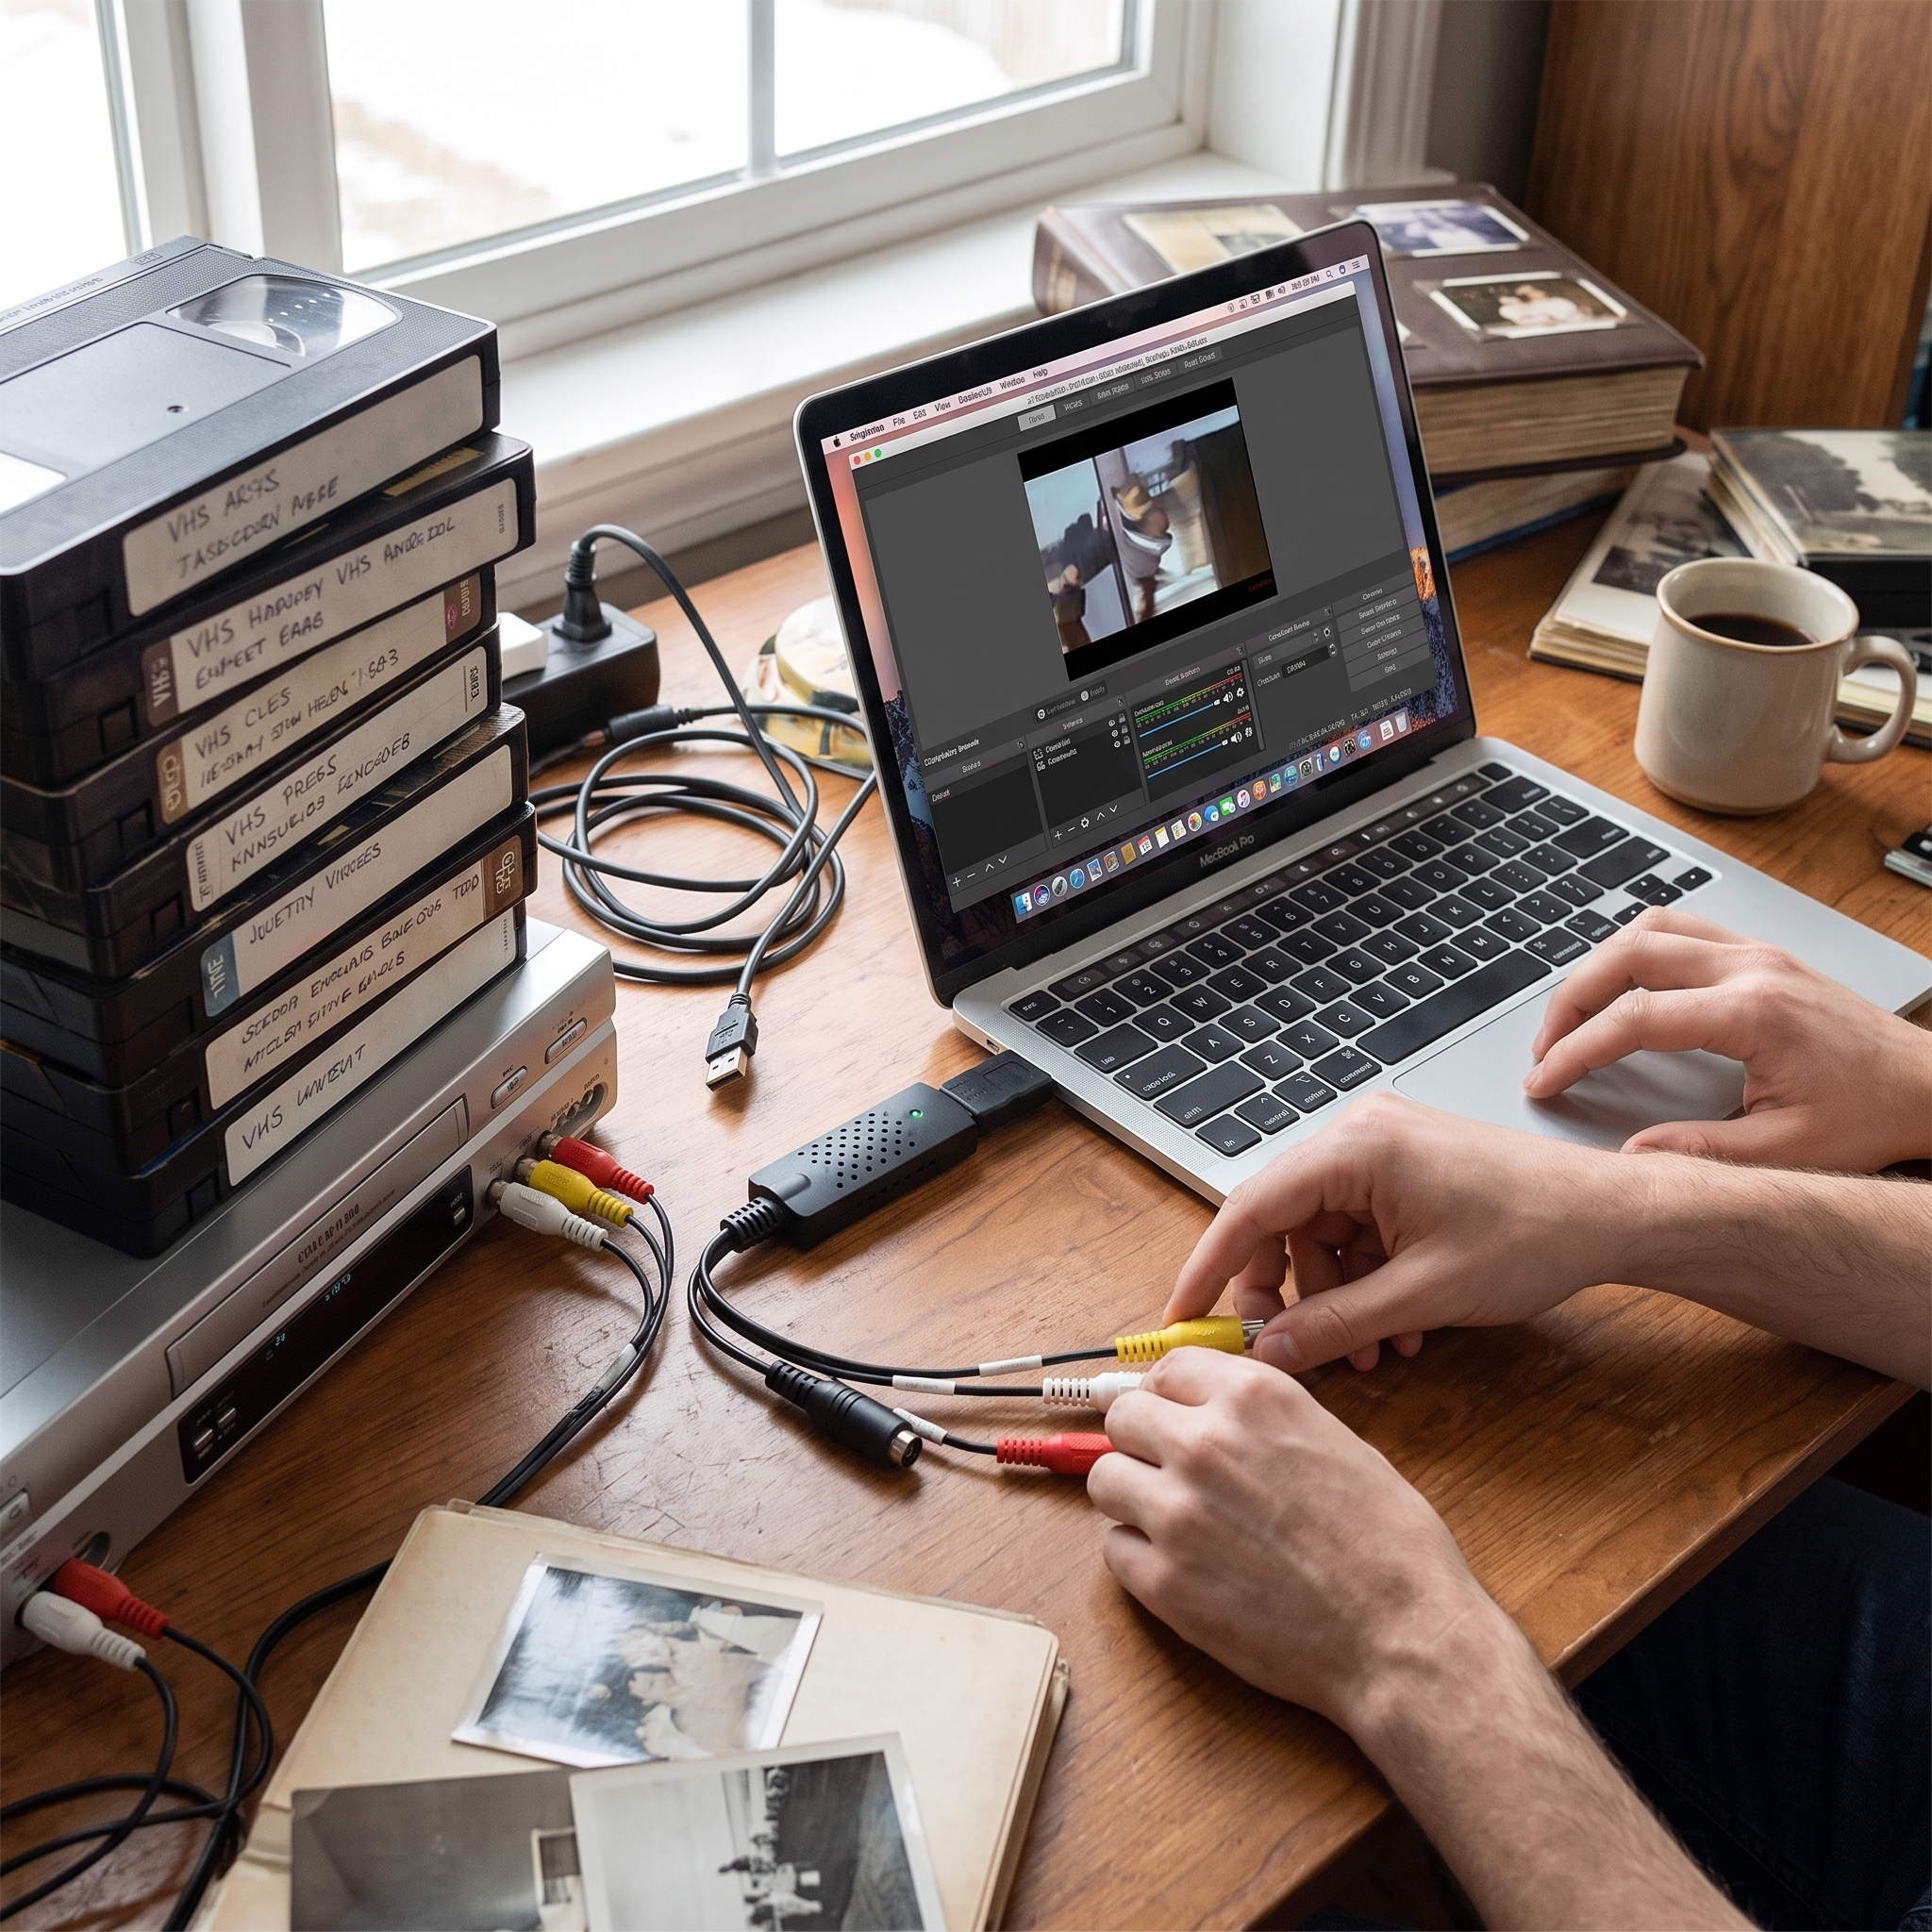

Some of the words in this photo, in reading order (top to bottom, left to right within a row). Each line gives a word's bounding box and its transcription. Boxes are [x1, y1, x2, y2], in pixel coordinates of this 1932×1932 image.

[167, 505, 209, 543] VHS
[187, 619, 235, 658] VHS
[336, 555, 373, 586] VHS
[195, 724, 232, 759] VHS
[225, 806, 266, 846] VHS
[1464, 854, 1474, 863] P
[1433, 871, 1445, 879] O
[1319, 894, 1329, 904] 7
[1368, 905, 1382, 914] U
[1449, 907, 1462, 915] K
[1285, 912, 1297, 921] 6
[1334, 923, 1346, 931] Y
[1419, 924, 1429, 933] J
[1250, 930, 1263, 939] 5
[1300, 941, 1312, 949] T
[1383, 941, 1397, 951] H
[1473, 937, 1489, 947] M
[1265, 959, 1279, 969] R
[1349, 960, 1362, 969] G
[1441, 956, 1456, 965] N
[1180, 967, 1192, 975] 3
[1230, 978, 1243, 988] E
[1407, 974, 1421, 984] B
[1314, 979, 1324, 989] F
[1143, 986, 1157, 995] 2
[1191, 996, 1208, 1008] W
[1372, 993, 1385, 1003] V
[1278, 999, 1291, 1008] D
[1158, 1017, 1172, 1026] Q
[1242, 1018, 1256, 1026] S
[1338, 1013, 1351, 1023] C
[1208, 1039, 1221, 1048] A
[1300, 1034, 1316, 1044] X
[1264, 1055, 1279, 1064] Z
[242, 1109, 284, 1151] VHS
